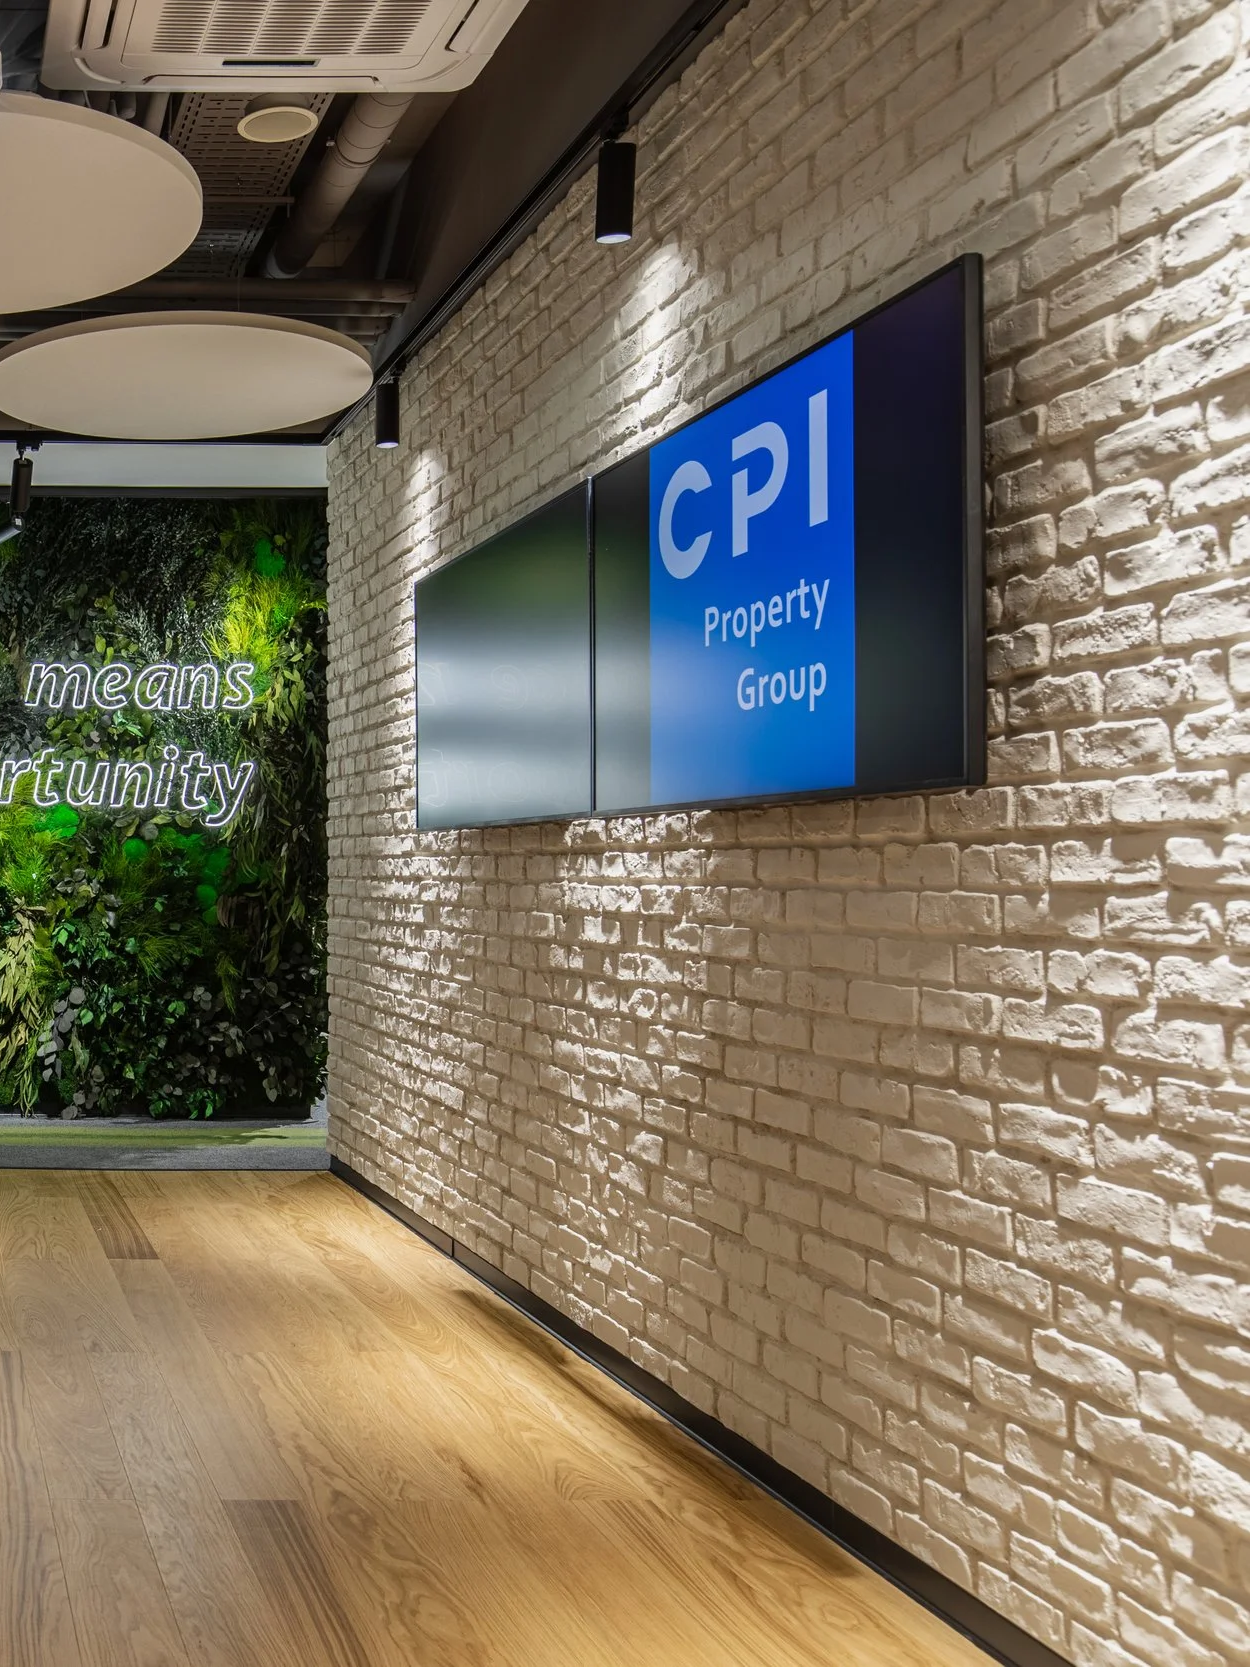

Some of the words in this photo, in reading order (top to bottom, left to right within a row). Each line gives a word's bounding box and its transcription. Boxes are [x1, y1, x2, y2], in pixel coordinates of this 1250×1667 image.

[658, 388, 829, 580] CPI
[704, 578, 831, 648] Property
[24, 660, 255, 710] means
[736, 661, 828, 712] Group
